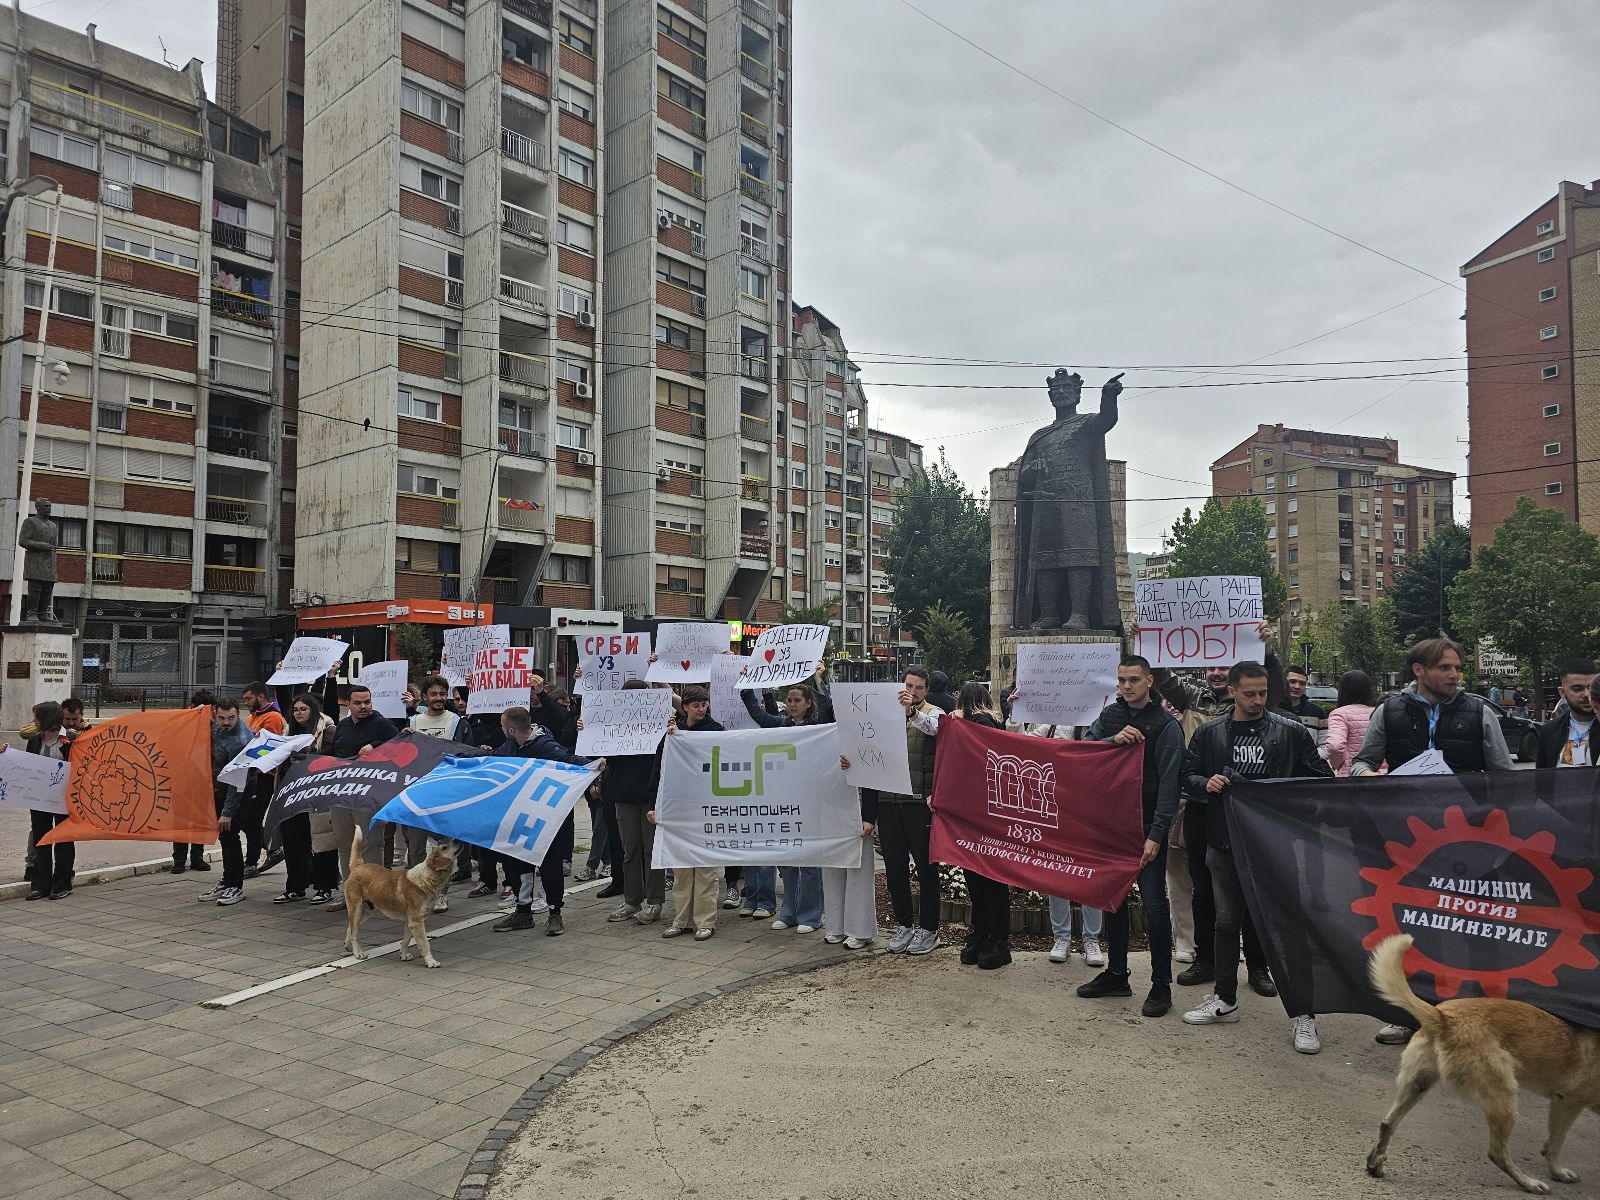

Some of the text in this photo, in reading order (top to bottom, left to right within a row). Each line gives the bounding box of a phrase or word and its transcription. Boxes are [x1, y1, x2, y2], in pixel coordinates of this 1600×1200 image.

[1136, 577, 1261, 603] СВЕ НАС РАНЕ
[1181, 600, 1221, 621] РОДА
[1228, 598, 1263, 619] БОЛЕ
[585, 635, 639, 656] СРБИ
[757, 626, 826, 648] СТУДЕНТИ
[1137, 621, 1264, 663] ПФБГ
[474, 648, 529, 671] НАС ЈЕ
[598, 655, 615, 671] УЗ
[778, 647, 791, 661] УЗ
[495, 669, 533, 690] ВИШЕ
[582, 670, 637, 691] СРБЕ
[740, 660, 813, 684] МАТУРАНТЕ
[582, 691, 670, 709] ОД БРИСЕЛА
[851, 691, 880, 713] КГ
[587, 706, 671, 725] ДО ОХРИДА
[858, 721, 876, 739] УЗ
[591, 740, 610, 754] СЕ
[857, 747, 886, 770] КМ
[132, 731, 172, 814] ФАКУЛТЕТ
[276, 767, 398, 801] ПОЛИТЕХНИКА
[283, 782, 372, 808] БЛОКАДИ
[701, 804, 801, 817] ТЕХНОЛОШКИ
[704, 821, 803, 835] ФАКУЛТЕТ
[1006, 823, 1043, 843] 1838
[765, 838, 803, 848] САД
[979, 835, 1030, 854] УНИВЕРЗИТЕТ
[1037, 850, 1076, 864] БЕОГРАДУ
[955, 839, 1096, 880] ФИЛОЗОФСКИ ФАКУЛТЕТ
[1428, 876, 1534, 902] МАШИНЦИ
[1437, 894, 1518, 919] ПРОТИВ
[1401, 909, 1549, 948] МАШИНЕРИЈЕ
